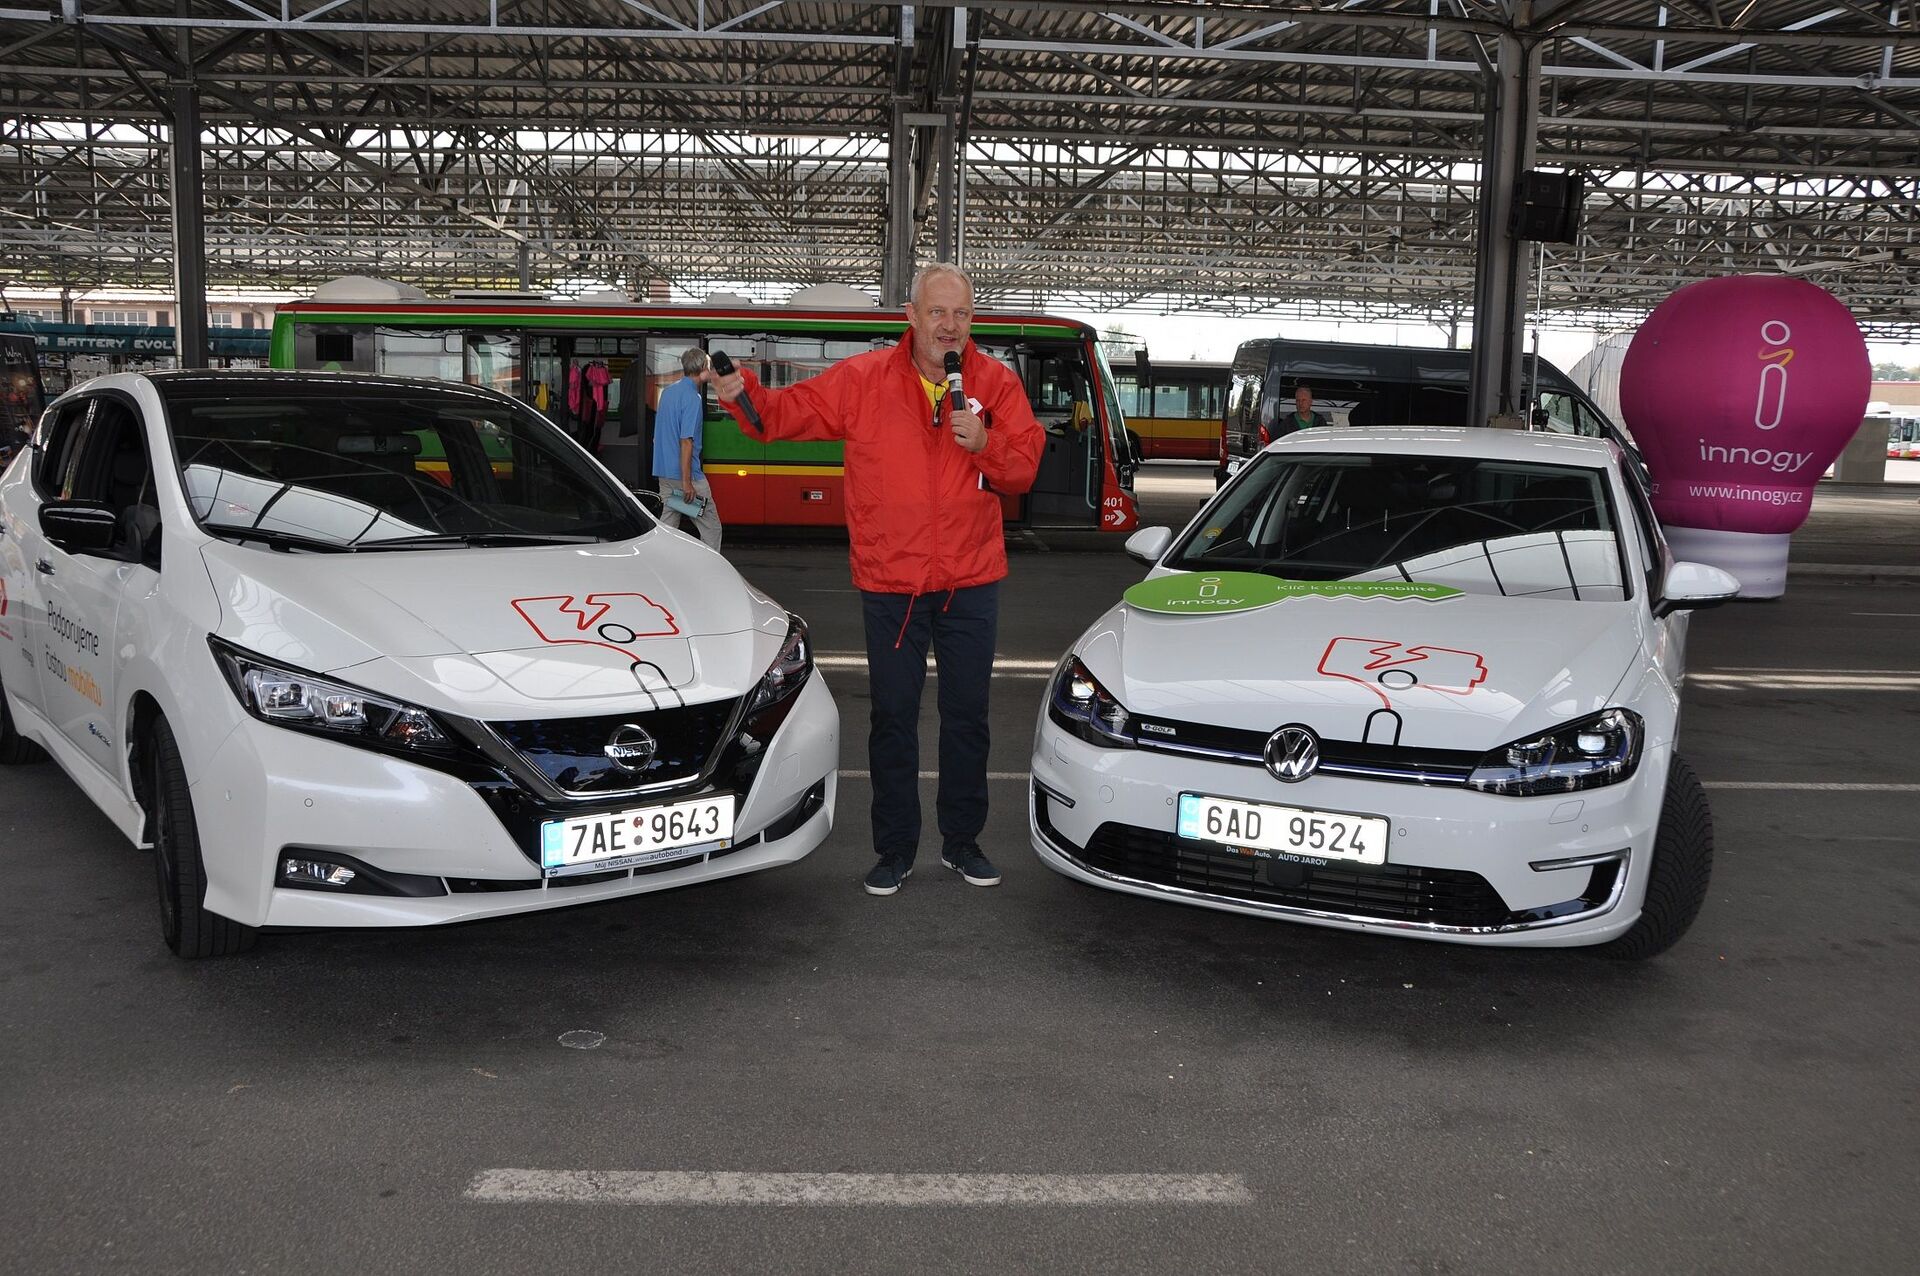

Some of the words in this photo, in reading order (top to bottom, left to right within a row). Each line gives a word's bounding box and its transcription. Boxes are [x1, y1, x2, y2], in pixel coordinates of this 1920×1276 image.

[57, 337, 125, 349] BATTERY
[1699, 438, 1814, 473] innogy
[1103, 497, 1123, 507] 401
[1689, 485, 1803, 505] www.innogy.cz
[1167, 598, 1245, 606] innogy
[48, 600, 99, 656] Podporujeme
[612, 742, 653, 757] NISSAN
[571, 819, 626, 857] 7AE
[651, 806, 719, 843] 9643
[1206, 805, 1262, 841] 6AD
[1288, 817, 1366, 855] 9524
[608, 857, 633, 867] NISSAN
[1226, 845, 1239, 854] Das
[1278, 853, 1300, 862] AUTO
[1301, 856, 1328, 866] JAROV
